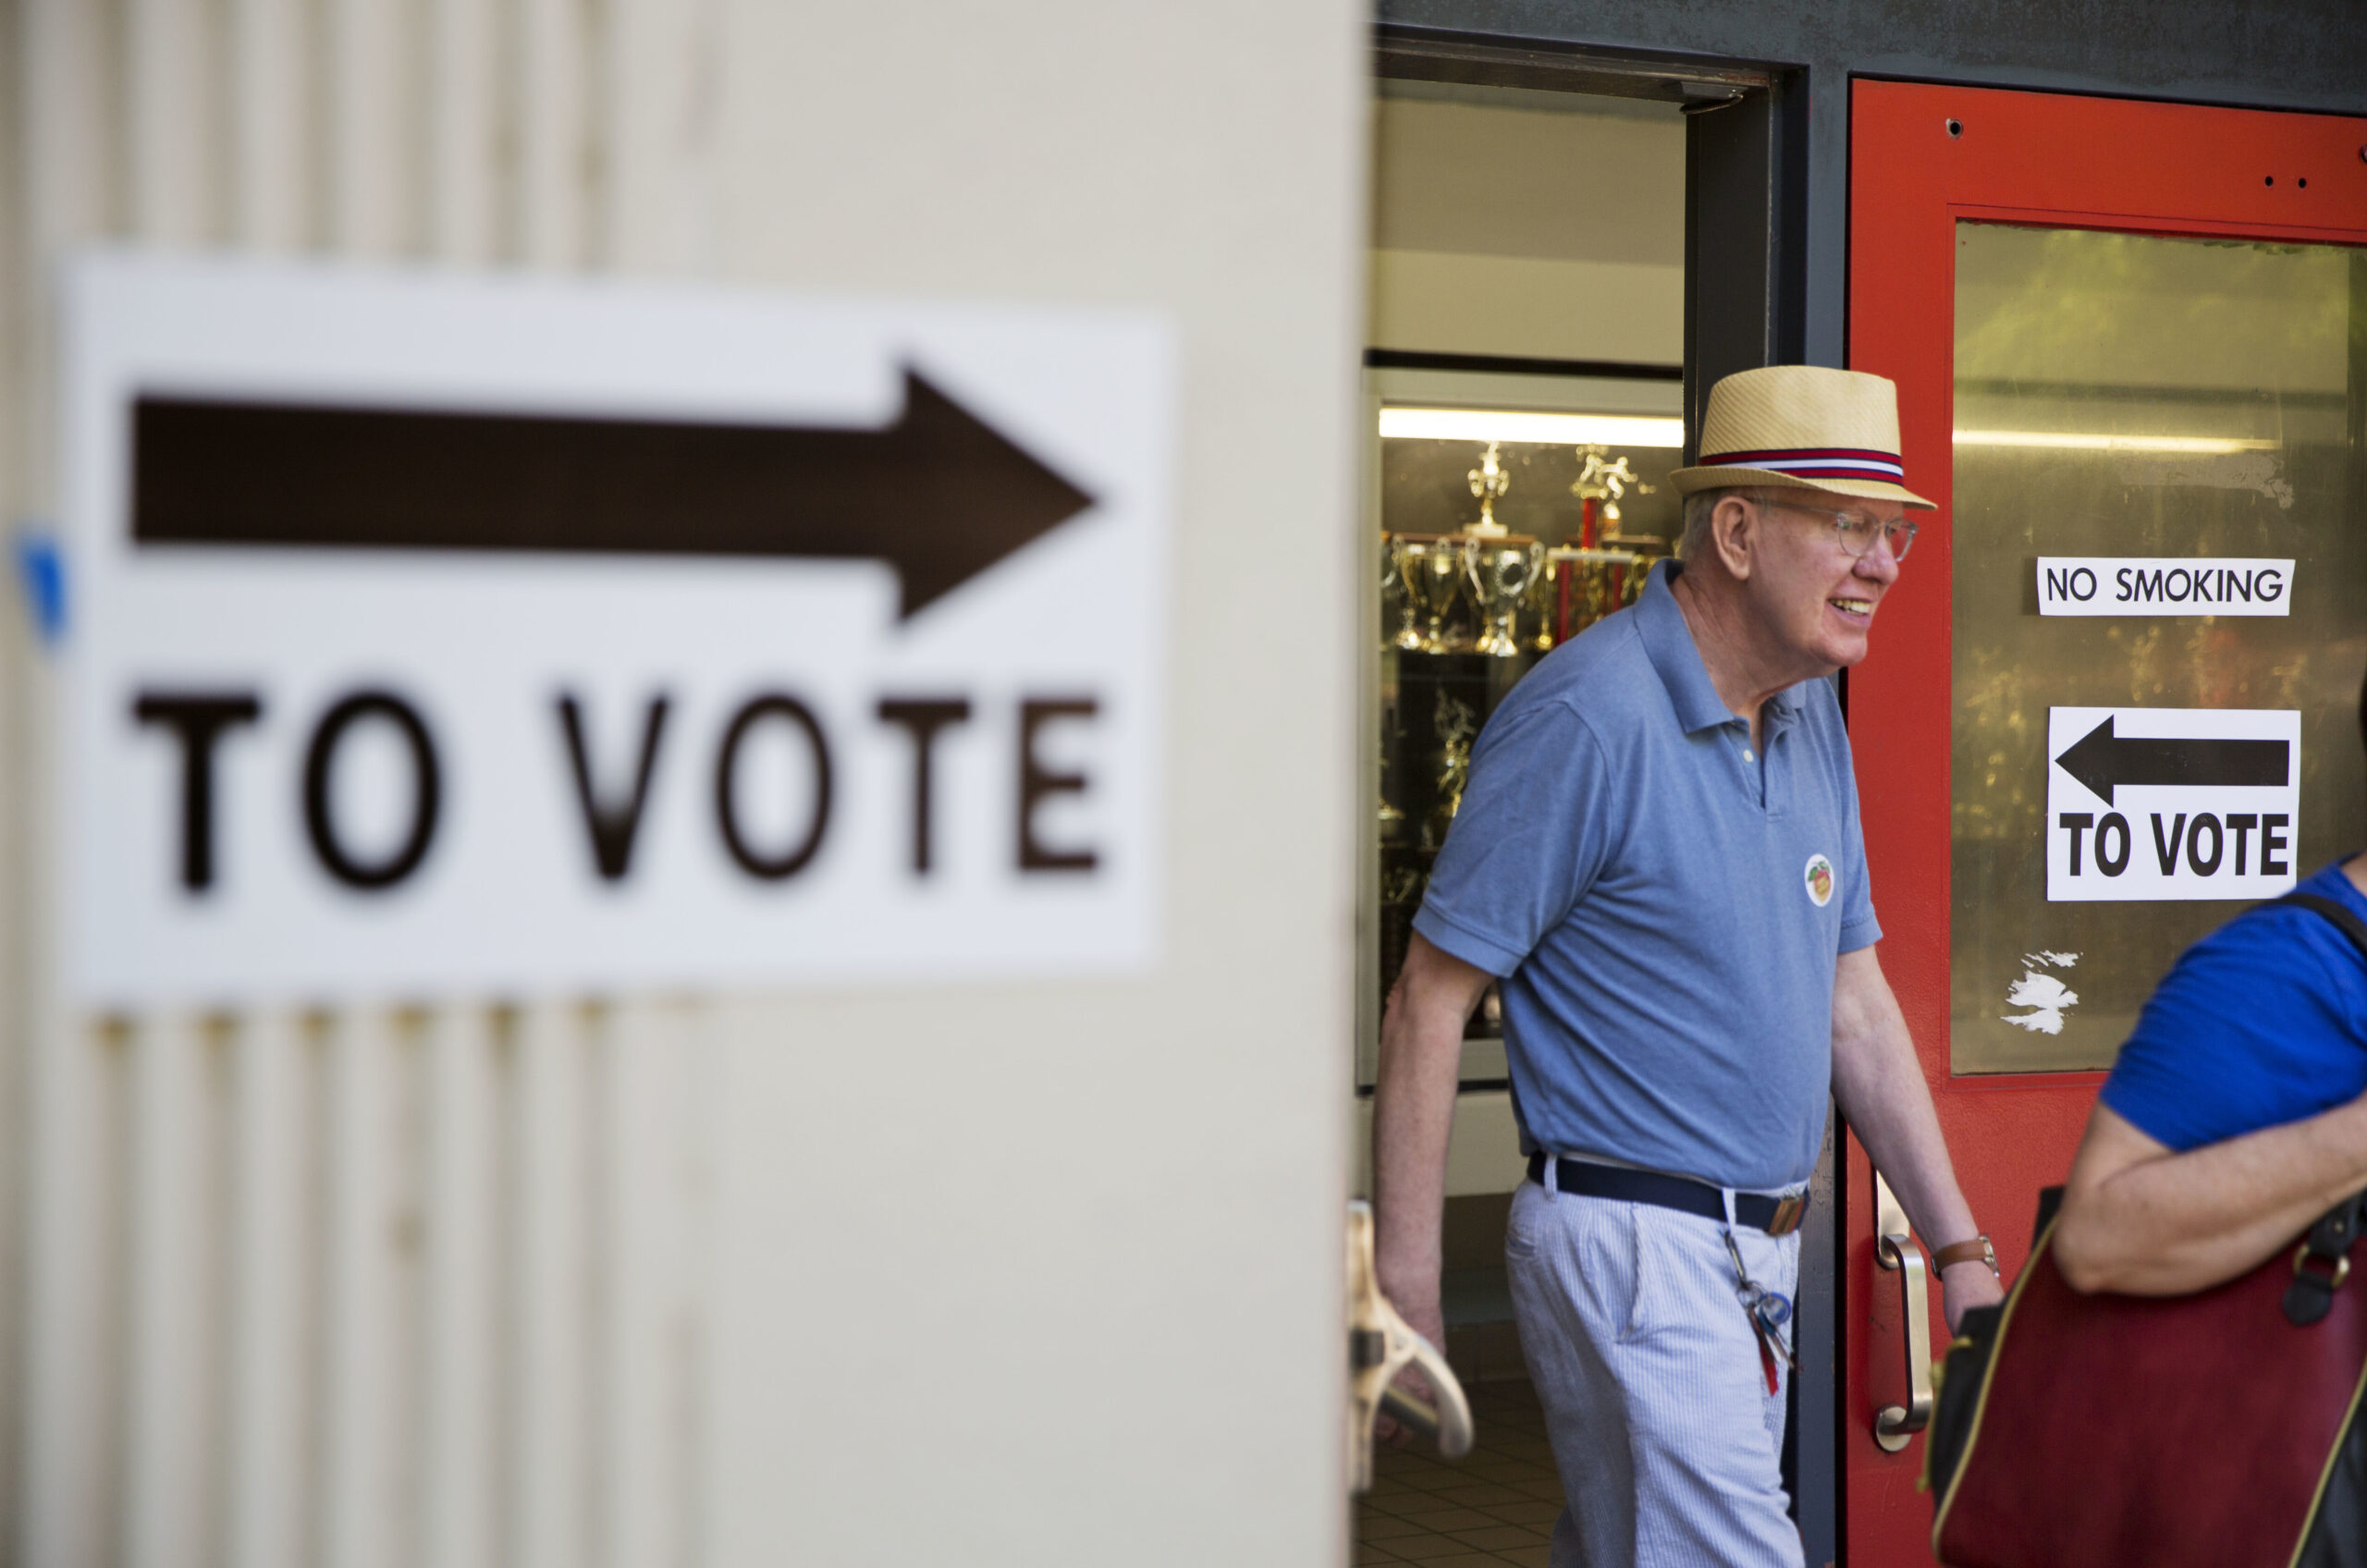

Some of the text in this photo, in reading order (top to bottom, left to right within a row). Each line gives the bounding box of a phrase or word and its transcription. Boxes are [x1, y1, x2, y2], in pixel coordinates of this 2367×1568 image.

[2046, 567, 2284, 603] NO SMOKING
[125, 682, 1104, 901] TO VOTE
[2058, 811, 2290, 877] TO VOTE
